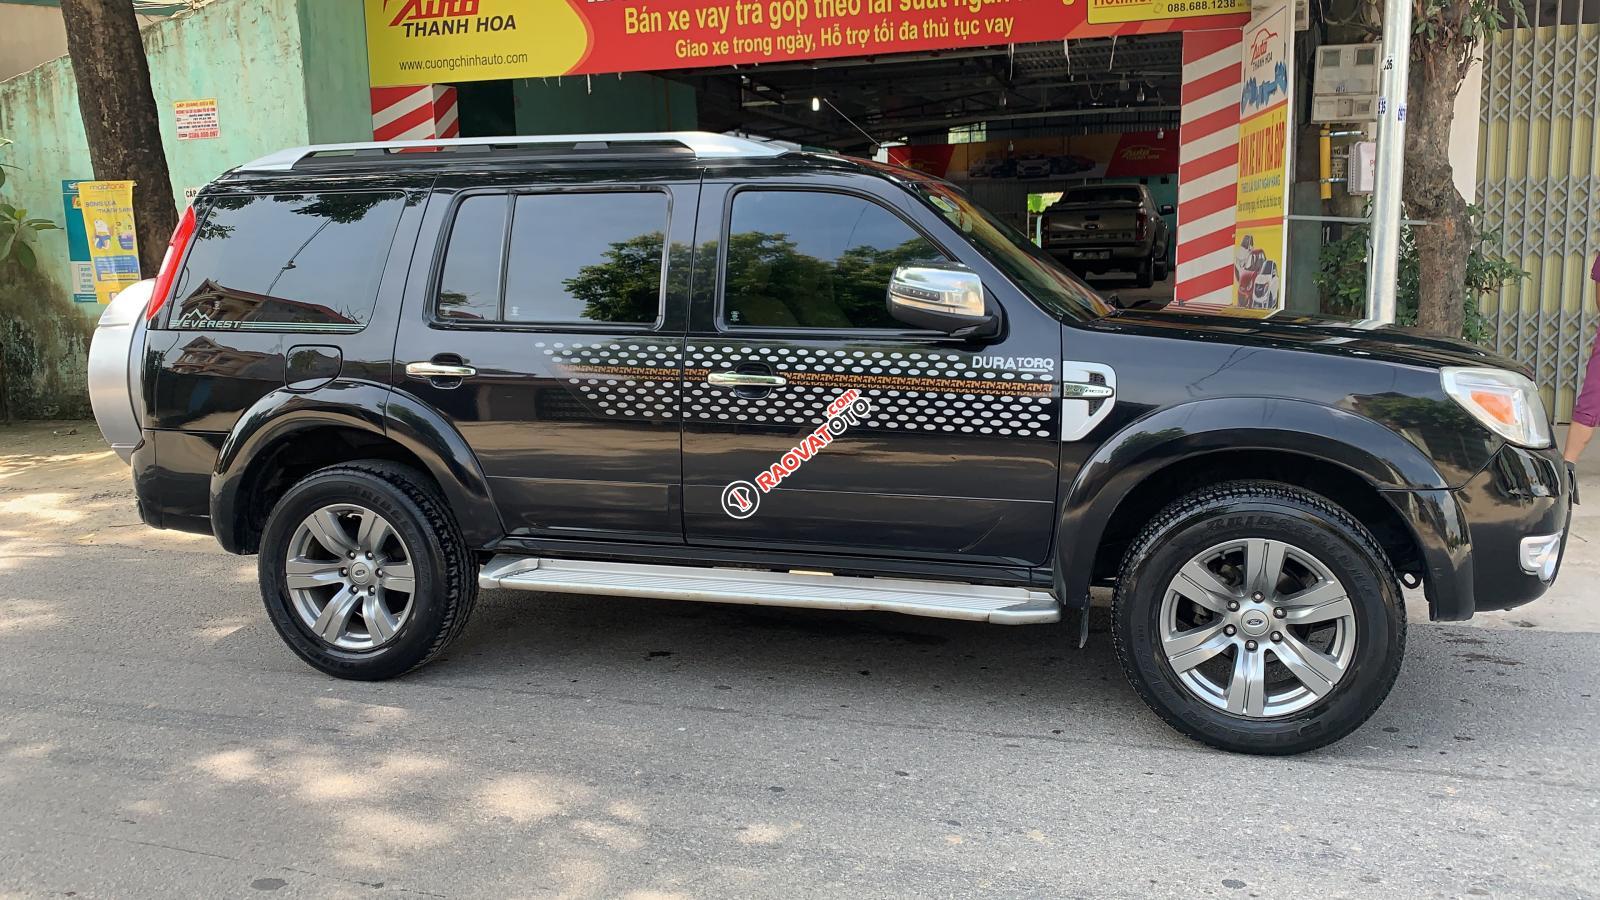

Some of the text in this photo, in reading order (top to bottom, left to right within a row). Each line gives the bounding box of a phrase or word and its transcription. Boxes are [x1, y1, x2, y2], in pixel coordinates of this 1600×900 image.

[1168, 0, 1236, 13] 088.688.1238
[402, 15, 517, 38] THANH HOA
[624, 6, 662, 34] Bán
[668, 9, 690, 31] xe
[695, 6, 729, 34] vay
[675, 16, 1014, 58] Giao xe trong ngày, Hỗ trợ tối đa thủ tục vay
[399, 52, 529, 71] www.cuongchinhauto.com
[182, 319, 242, 329] EVEREST
[972, 356, 1055, 371] DURATORQ
